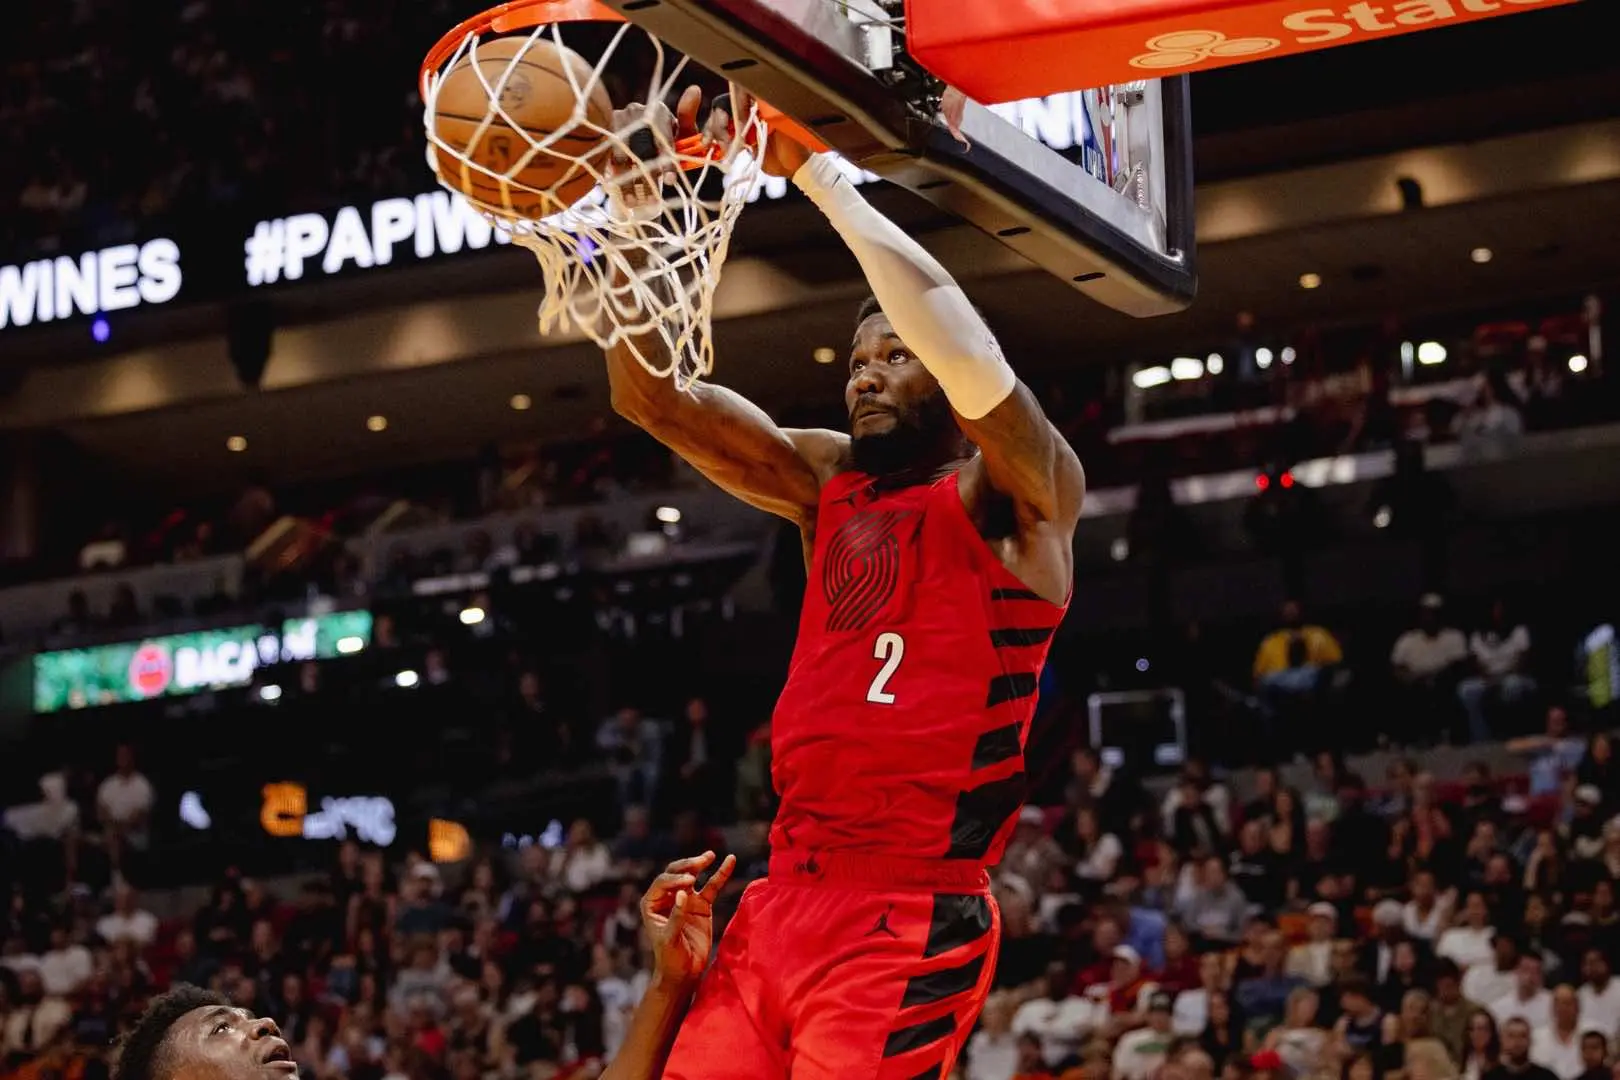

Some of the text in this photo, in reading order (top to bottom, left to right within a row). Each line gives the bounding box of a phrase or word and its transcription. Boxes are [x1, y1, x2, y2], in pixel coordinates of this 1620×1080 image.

[1282, 0, 1546, 43] Sta
[244, 184, 609, 287] #PAPIW
[866, 631, 905, 704] 2
